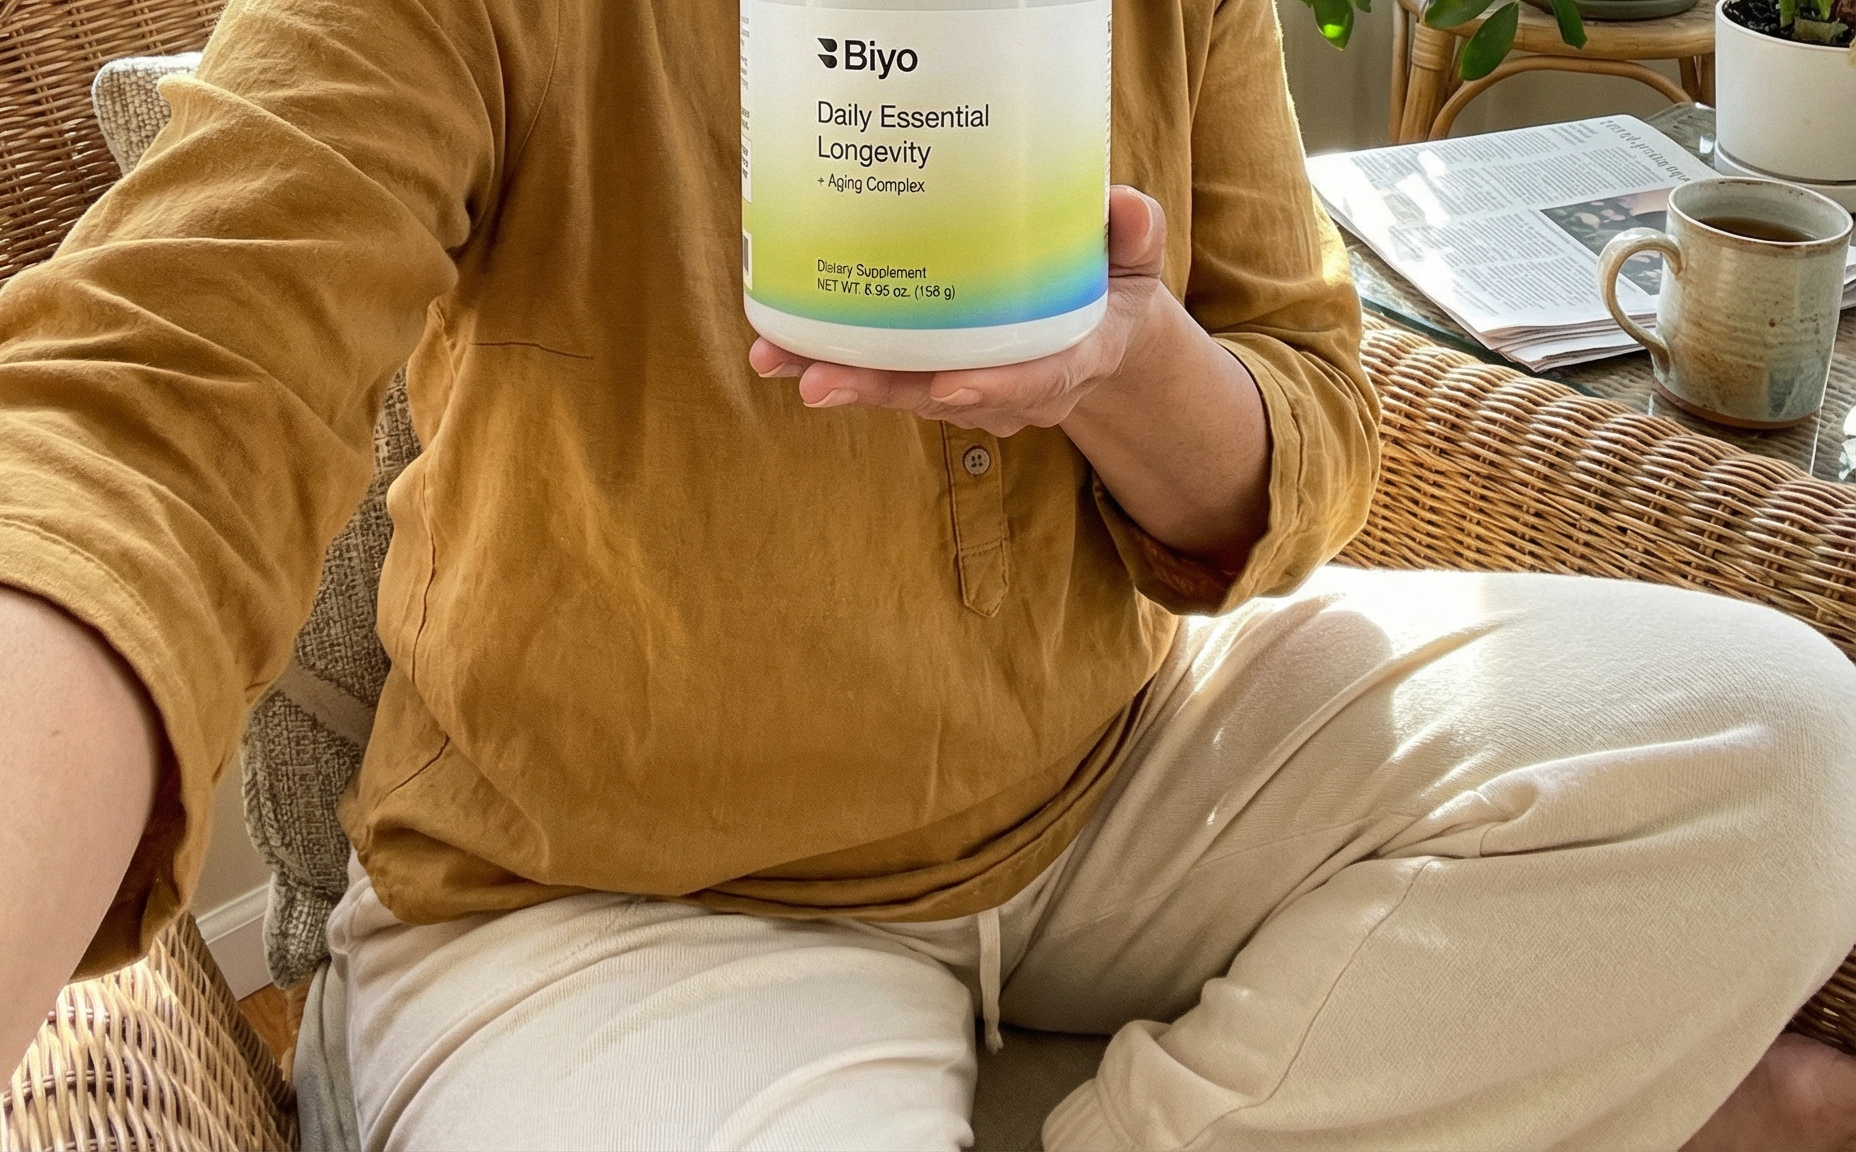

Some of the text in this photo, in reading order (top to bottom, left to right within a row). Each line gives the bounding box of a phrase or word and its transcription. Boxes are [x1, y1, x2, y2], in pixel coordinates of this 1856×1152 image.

[844, 39, 919, 80] Biyo
[817, 100, 990, 133] Daily Essential
[817, 135, 932, 170] Longevity
[828, 173, 863, 194] Aging
[866, 176, 925, 195] Complex
[856, 263, 927, 279] Supplement
[817, 278, 839, 292] NET
[841, 280, 861, 295] WT.
[944, 285, 956, 301] g)
